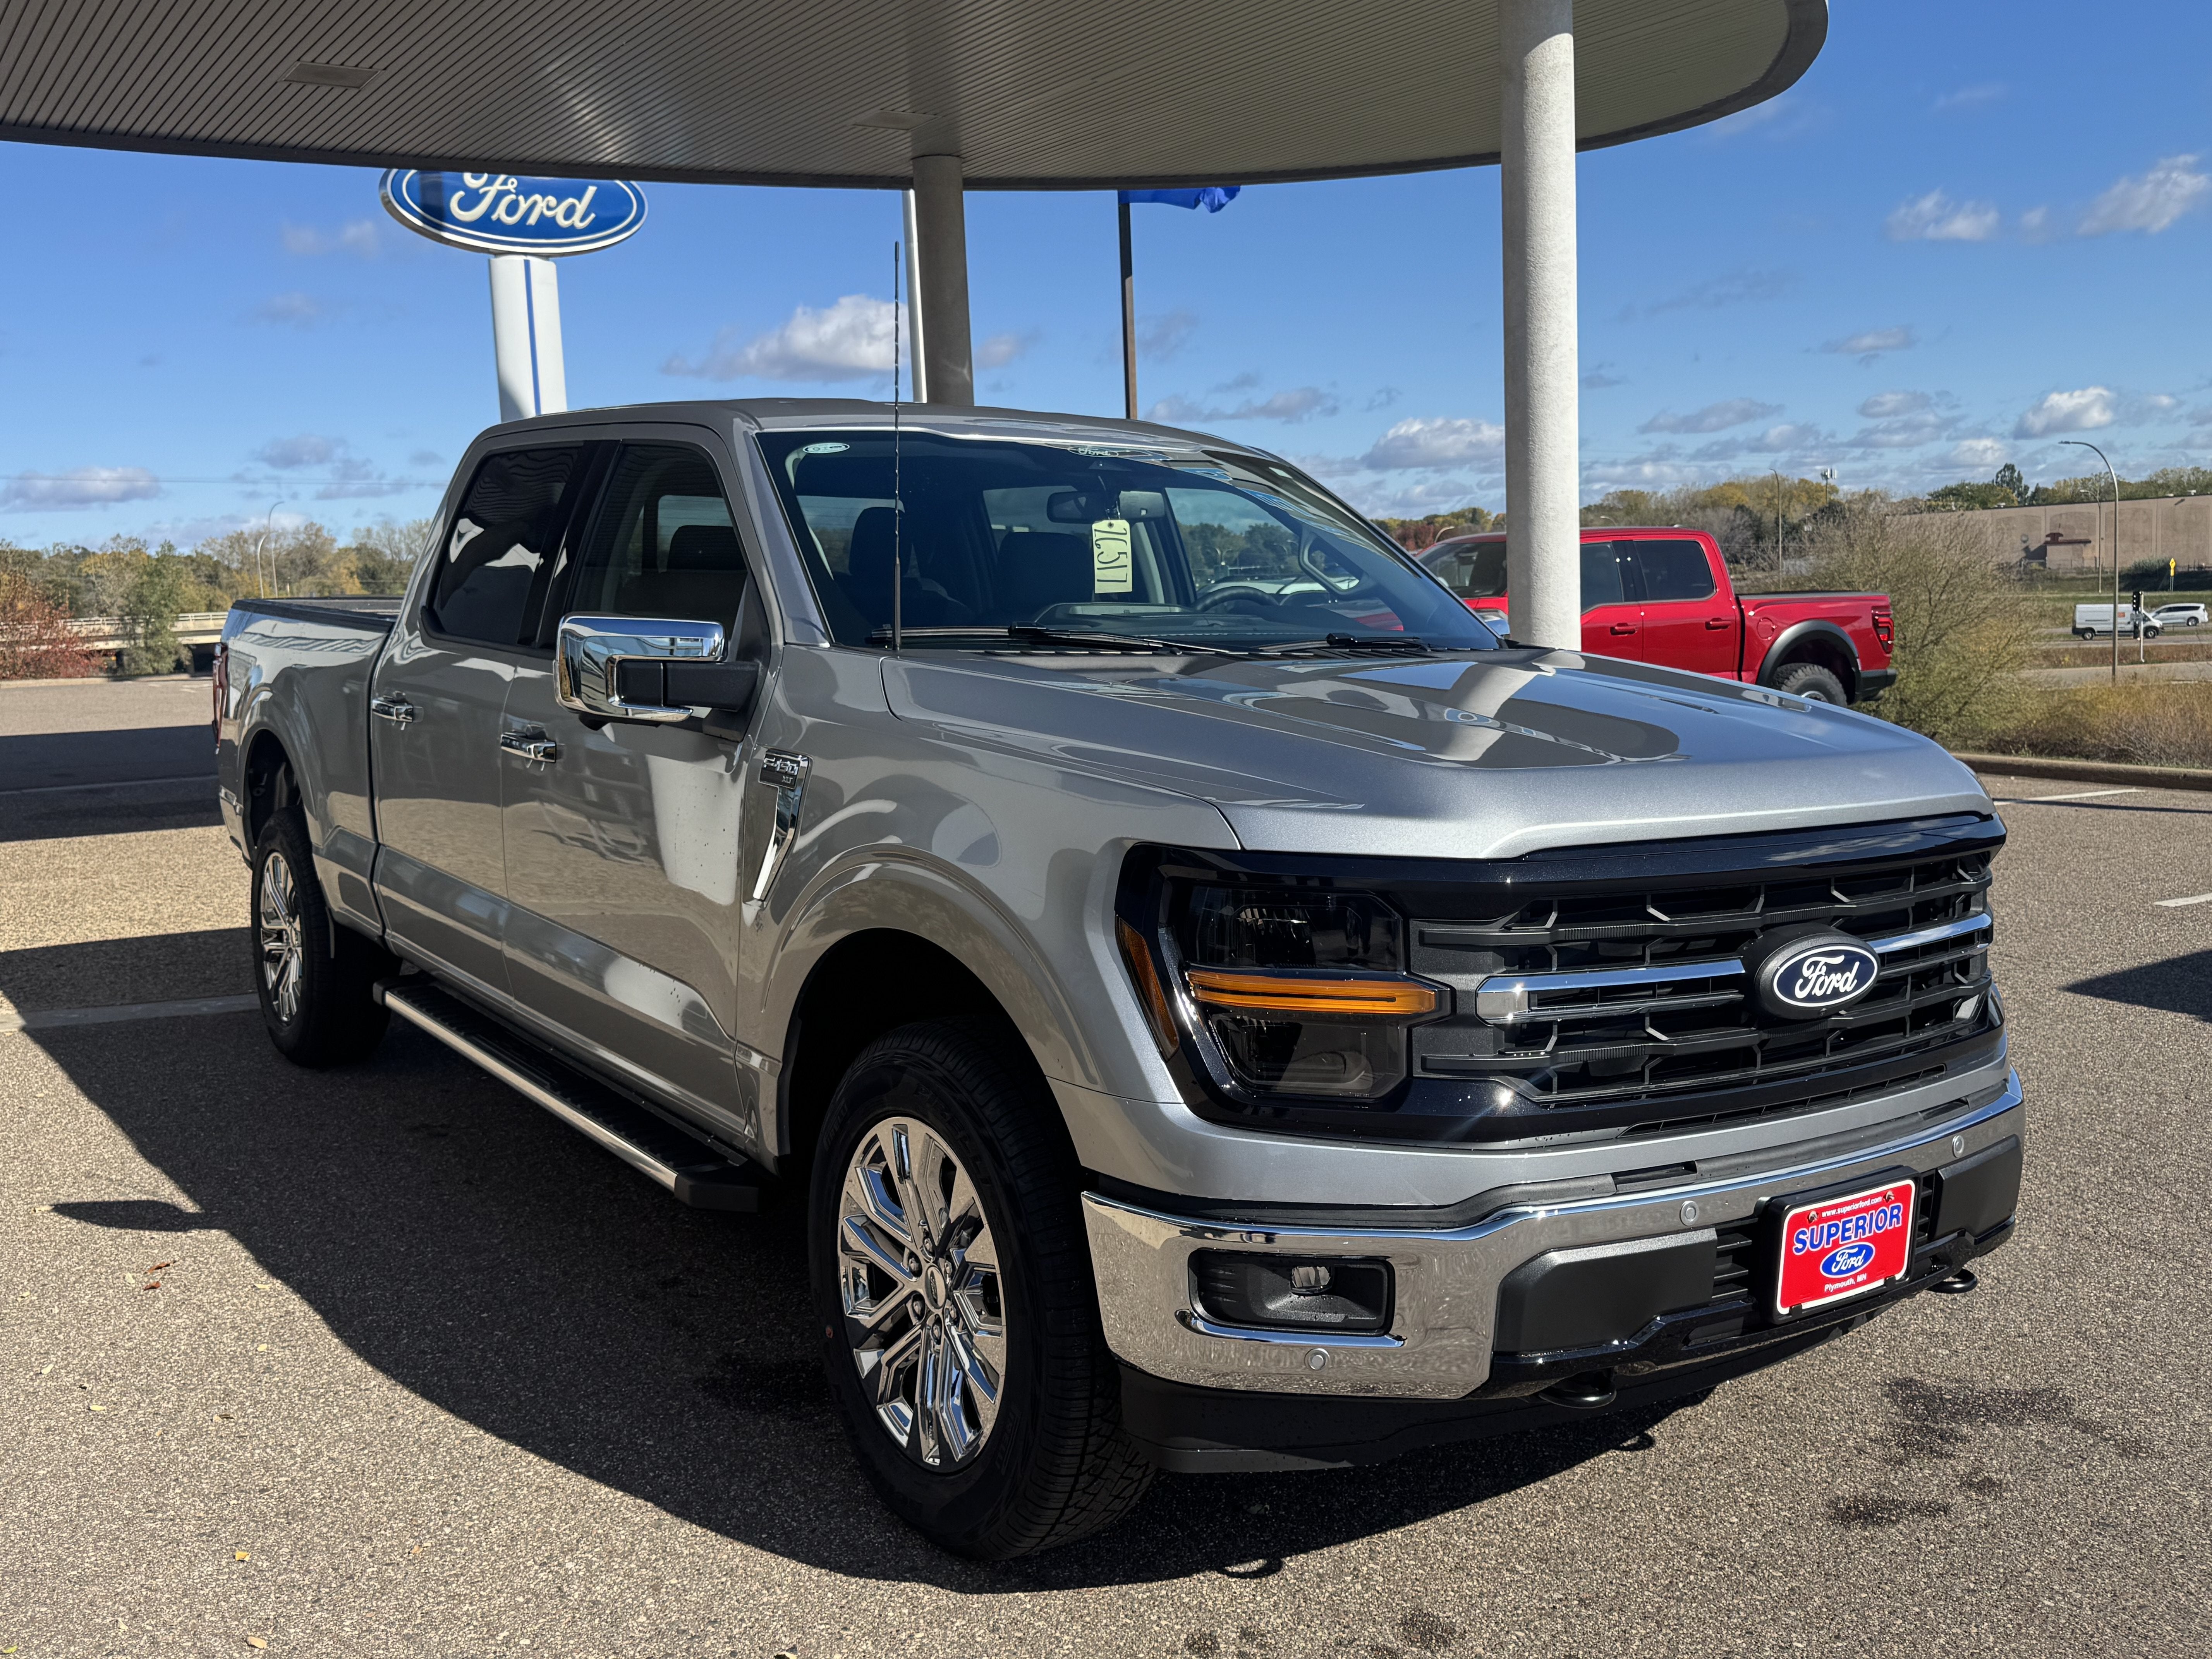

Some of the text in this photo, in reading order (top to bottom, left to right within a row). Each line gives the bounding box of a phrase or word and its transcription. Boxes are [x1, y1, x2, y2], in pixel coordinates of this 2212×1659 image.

[449, 172, 597, 229] Ford
[781, 775, 793, 784] XLT
[1795, 955, 1860, 999] Ford
[1821, 1196, 1882, 1218] www.superiorford.com
[1793, 1203, 1903, 1255] SUPERIOR
[1831, 1247, 1866, 1273] Ford
[1824, 1273, 1867, 1293] Plymouth, MN
